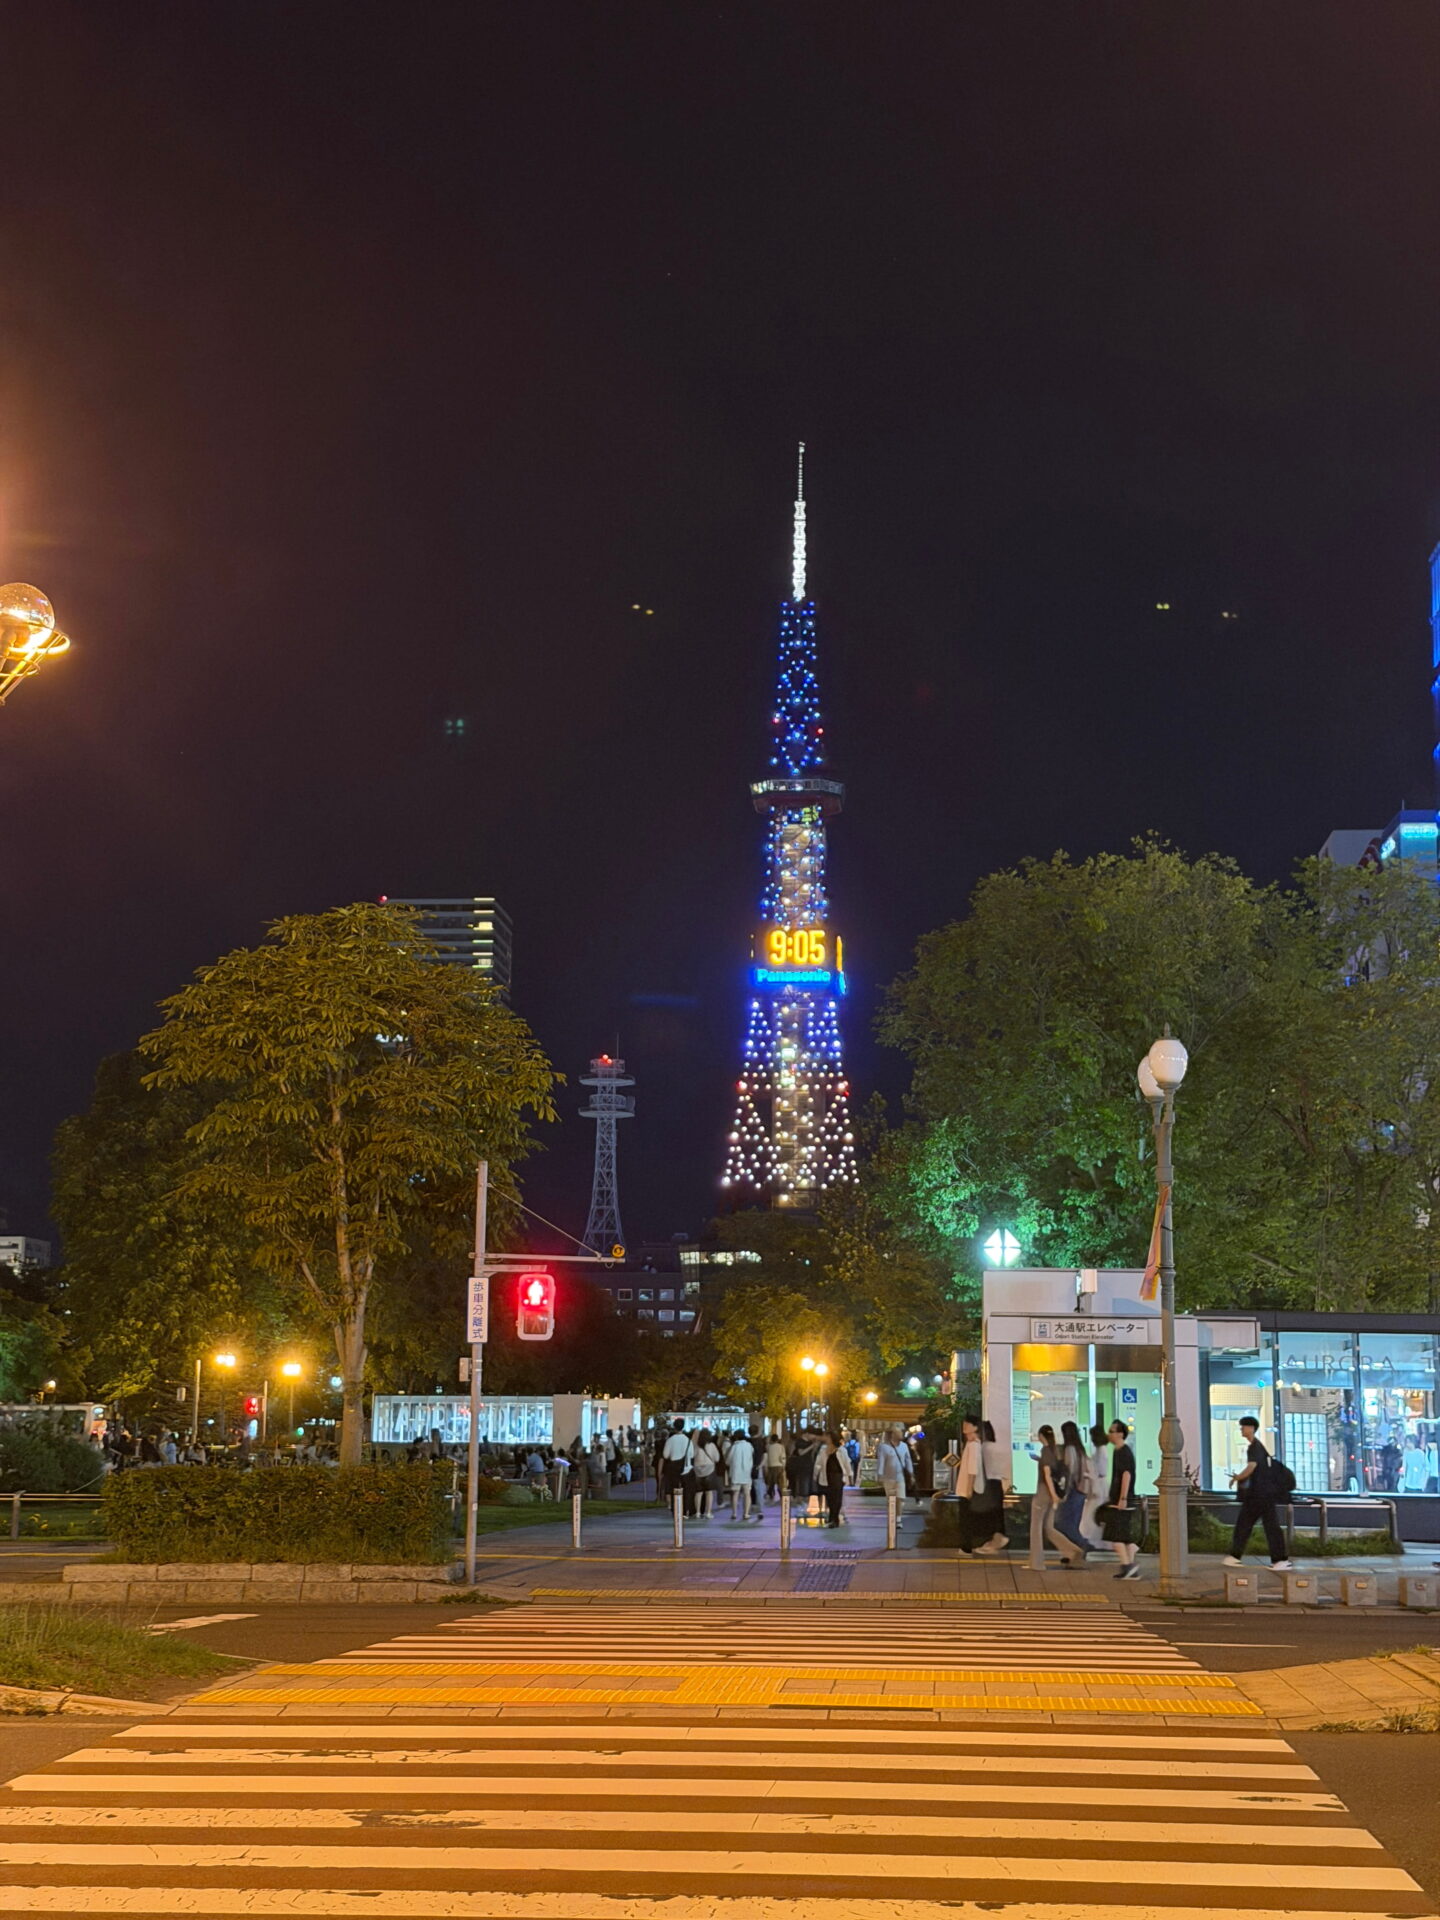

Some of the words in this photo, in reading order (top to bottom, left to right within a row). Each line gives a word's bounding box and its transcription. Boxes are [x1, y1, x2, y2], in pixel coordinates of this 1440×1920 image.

[769, 930, 826, 965] 9:05
[757, 969, 831, 982] Panasonic
[472, 1281, 484, 1339] 歩車分離式
[1054, 1321, 1144, 1333] 大通駅エレベーター
